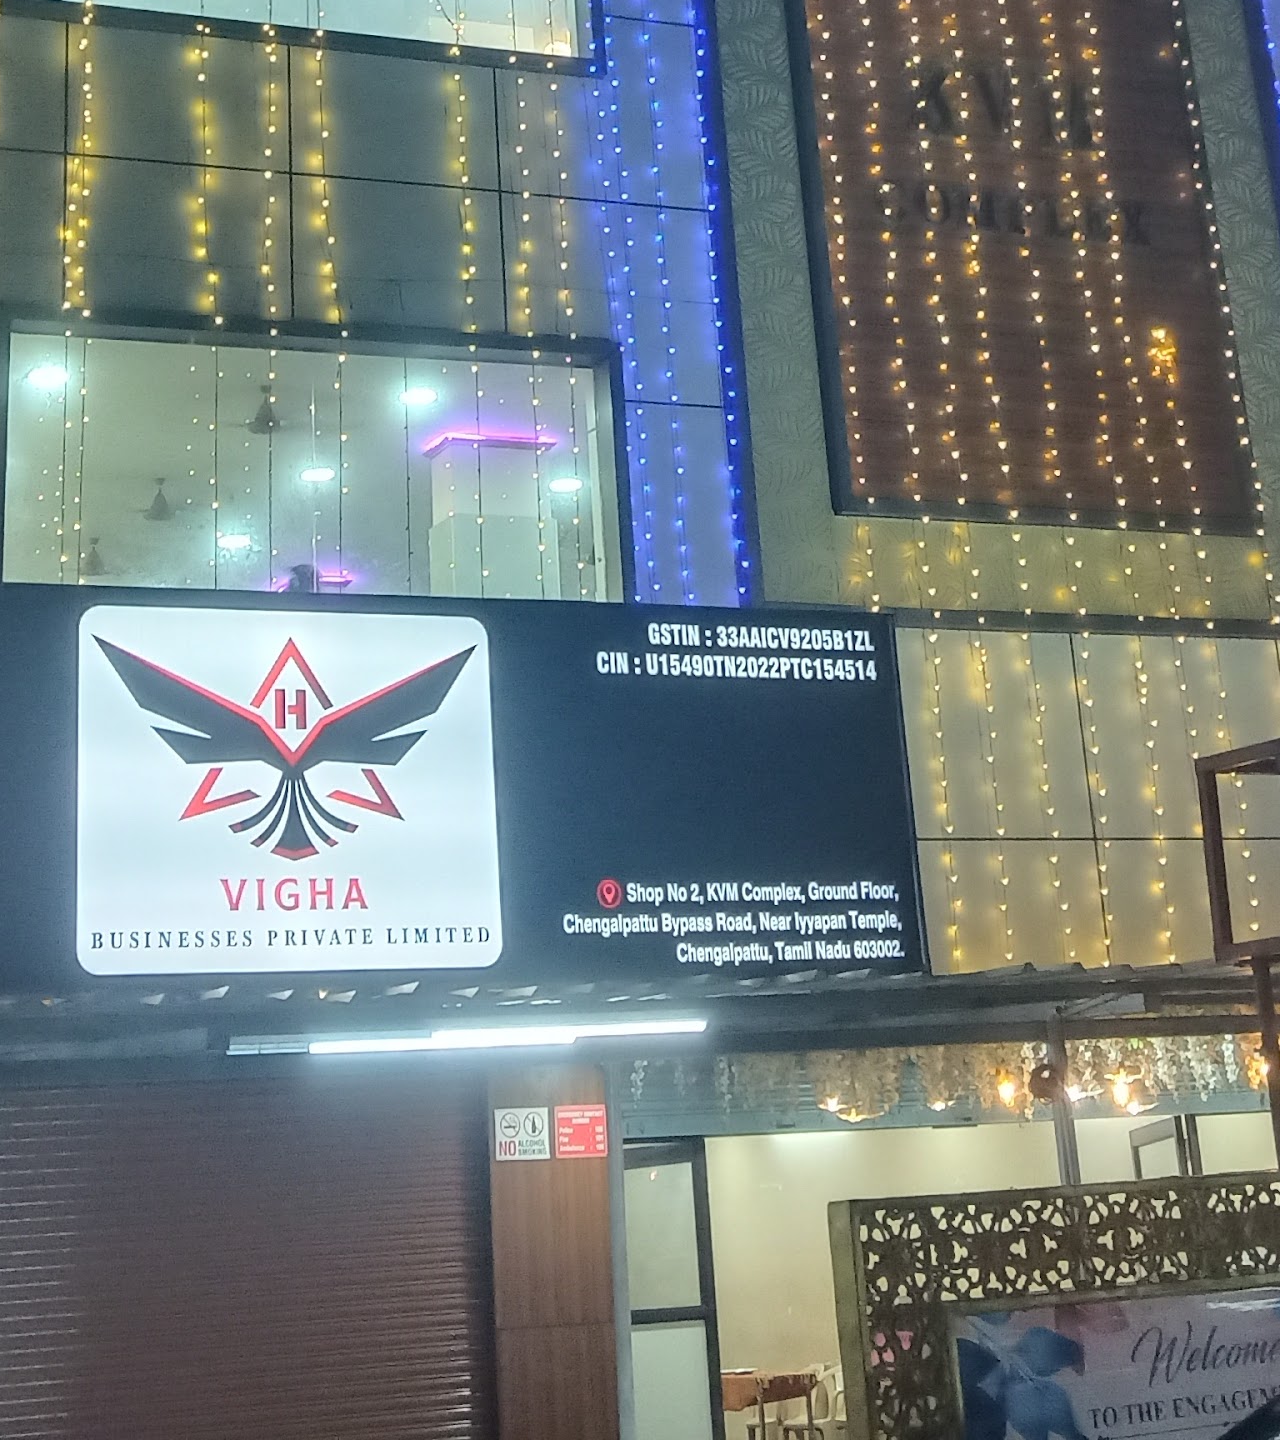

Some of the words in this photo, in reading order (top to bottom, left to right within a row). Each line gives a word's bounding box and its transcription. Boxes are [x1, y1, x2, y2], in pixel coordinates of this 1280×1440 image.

[647, 623, 700, 647] GSTIN
[704, 629, 713, 647] :
[716, 625, 875, 652] 33AAICV9205B1ZL
[596, 651, 629, 675] CIN
[633, 657, 642, 675] :
[645, 653, 877, 681] U15490TN2022PTC154514
[219, 878, 369, 911] VIGHA
[626, 884, 664, 906] Shop
[667, 883, 687, 902] No
[690, 883, 704, 905] 2,
[707, 883, 739, 902] KVM
[742, 882, 806, 905] Complex,
[808, 883, 858, 900] Ground
[861, 883, 900, 902] Floor,
[91, 930, 254, 949] BUSINESSES
[267, 929, 374, 947] PRIVATE
[386, 926, 491, 944] LIMITED
[563, 914, 658, 938] Chengalpattu
[661, 914, 713, 937] Bypass
[716, 913, 757, 934] Road,
[759, 912, 792, 931] Near
[795, 912, 847, 935] Iyyapan
[848, 910, 902, 934] Temple,
[677, 943, 773, 966] Chengalpattu,
[775, 942, 813, 960] Tamil
[816, 941, 851, 959] Nadu
[854, 940, 905, 958] 603002.
[500, 1140, 517, 1157] NO
[518, 1140, 546, 1148] ALCOHOL
[1089, 1407, 1118, 1429] TO
[1123, 1400, 1167, 1424] THE
